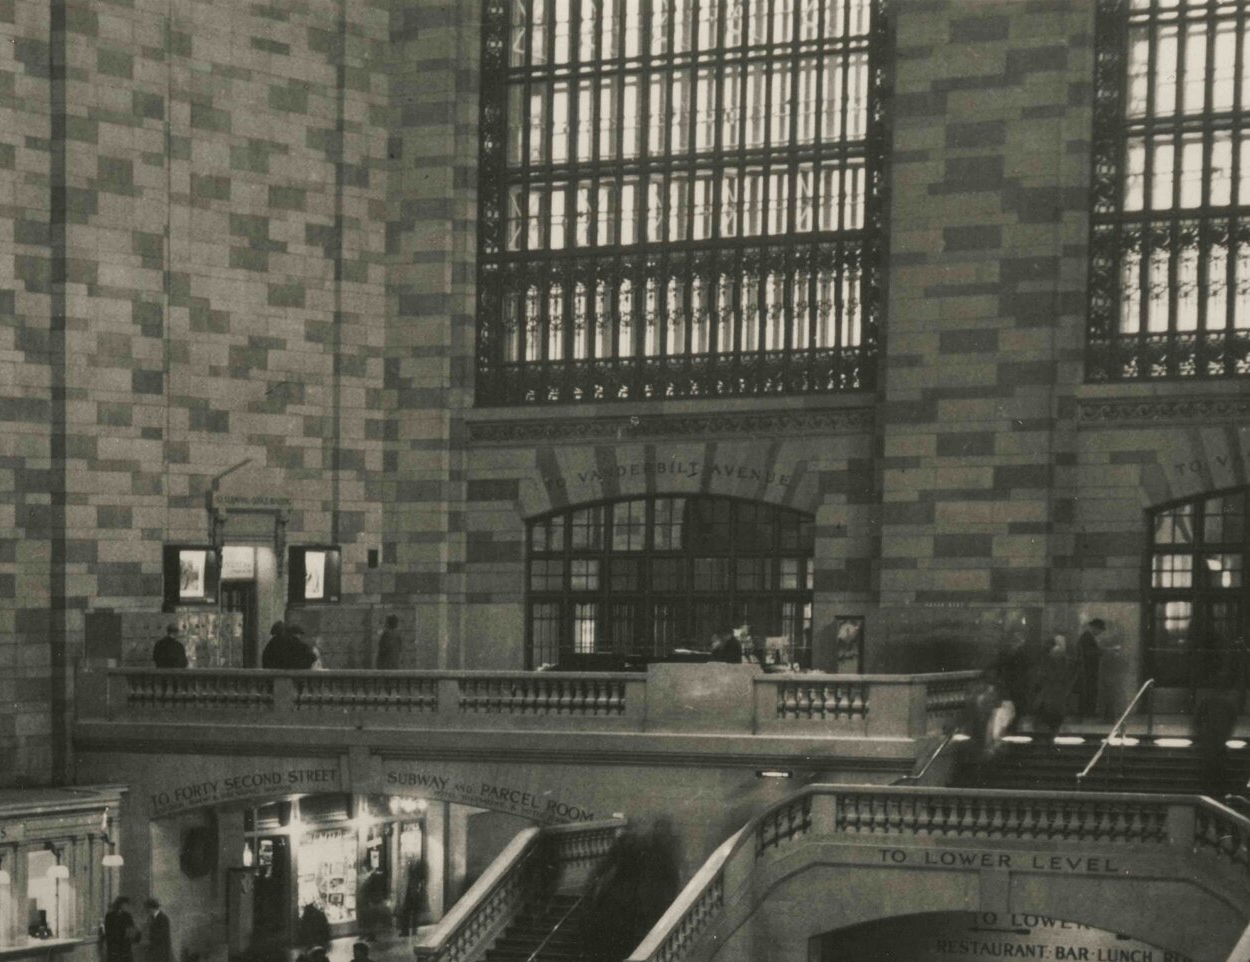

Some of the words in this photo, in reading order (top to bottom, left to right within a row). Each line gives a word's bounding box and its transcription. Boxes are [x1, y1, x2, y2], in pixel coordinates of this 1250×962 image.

[577, 461, 699, 483] VANDERBILT
[712, 464, 791, 487] AVENUE
[1174, 460, 1202, 476] TO
[151, 793, 170, 809] TO
[174, 780, 218, 802] FORTY
[224, 772, 282, 791] SECOND
[288, 768, 337, 784] STREET
[386, 771, 450, 790] SUBWAY
[454, 782, 473, 794] AND
[480, 783, 542, 809] PARCEL
[546, 799, 595, 822] ROOM
[878, 848, 907, 863] TO
[925, 851, 1012, 868] LOWER
[1033, 856, 1119, 873] LEVEL
[937, 938, 1046, 959] RESTAURANT
[1055, 943, 1089, 961] BAR
